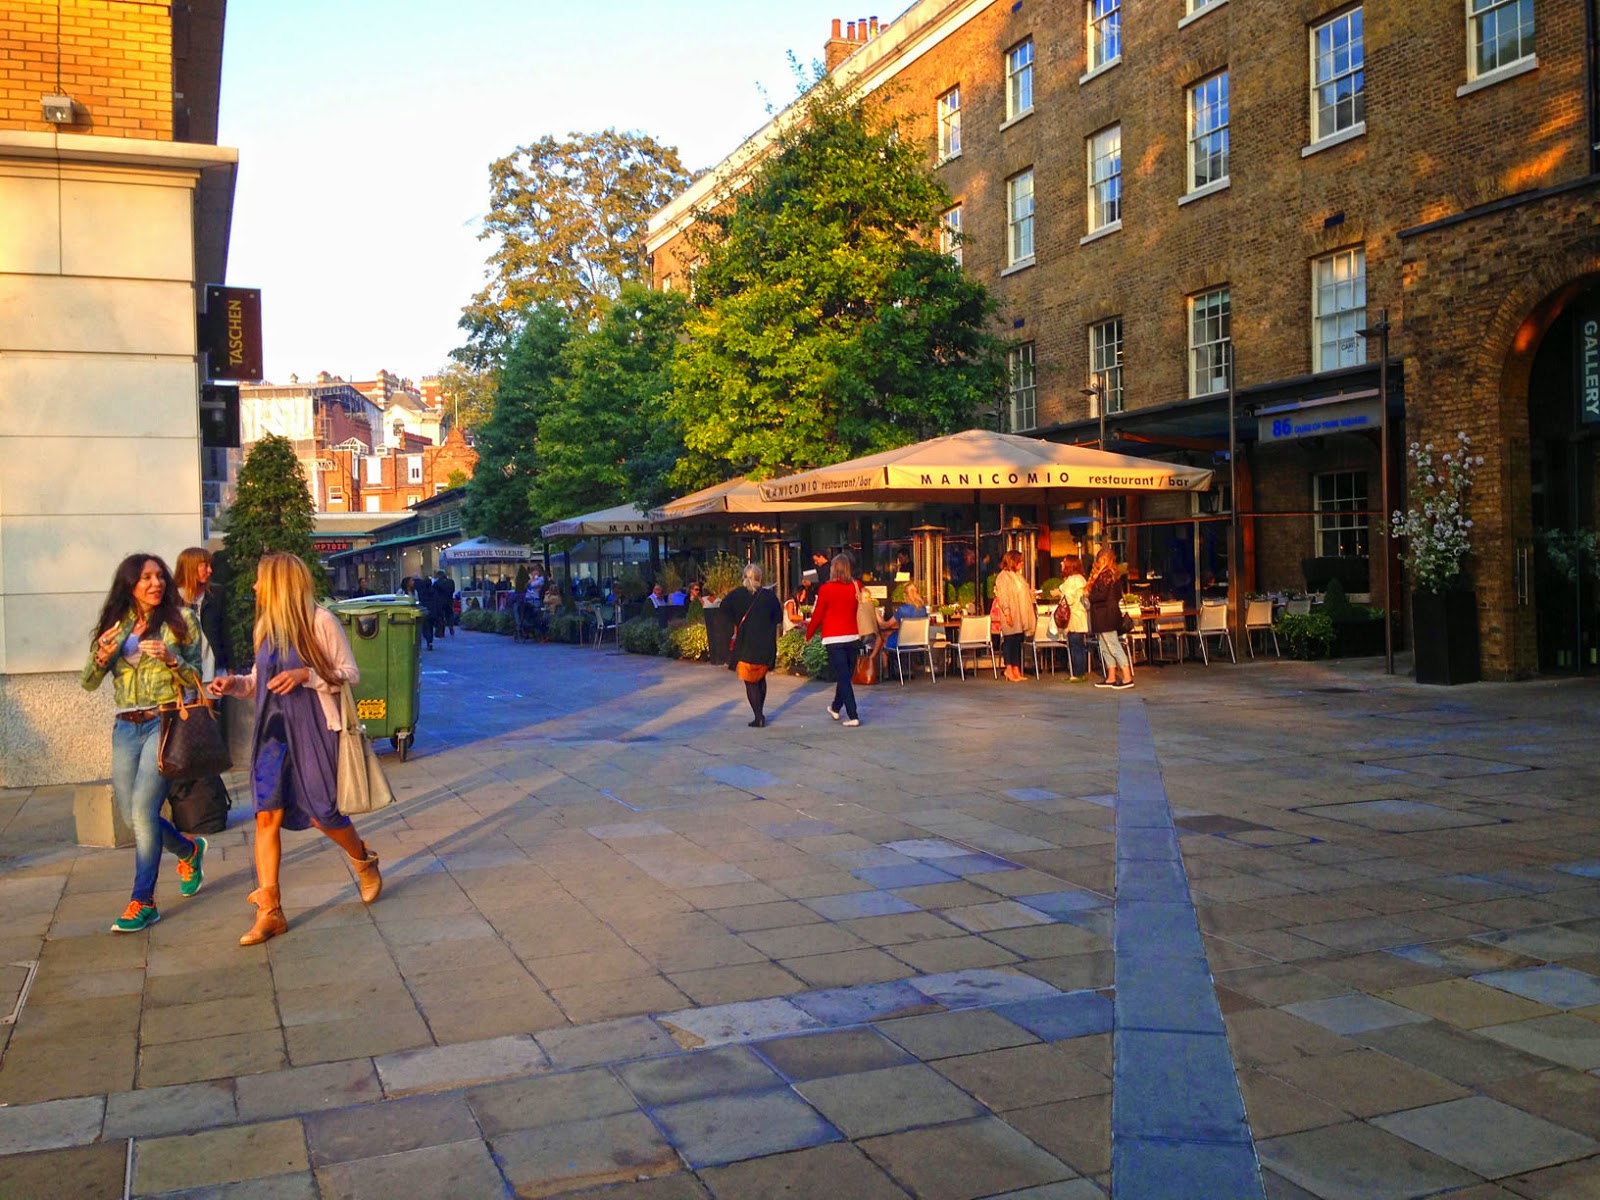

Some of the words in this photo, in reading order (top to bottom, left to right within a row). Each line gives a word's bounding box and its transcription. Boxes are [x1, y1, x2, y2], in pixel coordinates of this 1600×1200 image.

[228, 300, 243, 366] TASCHEN
[1584, 320, 1600, 415] GALLERY
[1272, 418, 1293, 438] 86
[920, 471, 1070, 486] MANICOMIO
[1088, 474, 1154, 486] restaurant
[1167, 475, 1190, 488] bar
